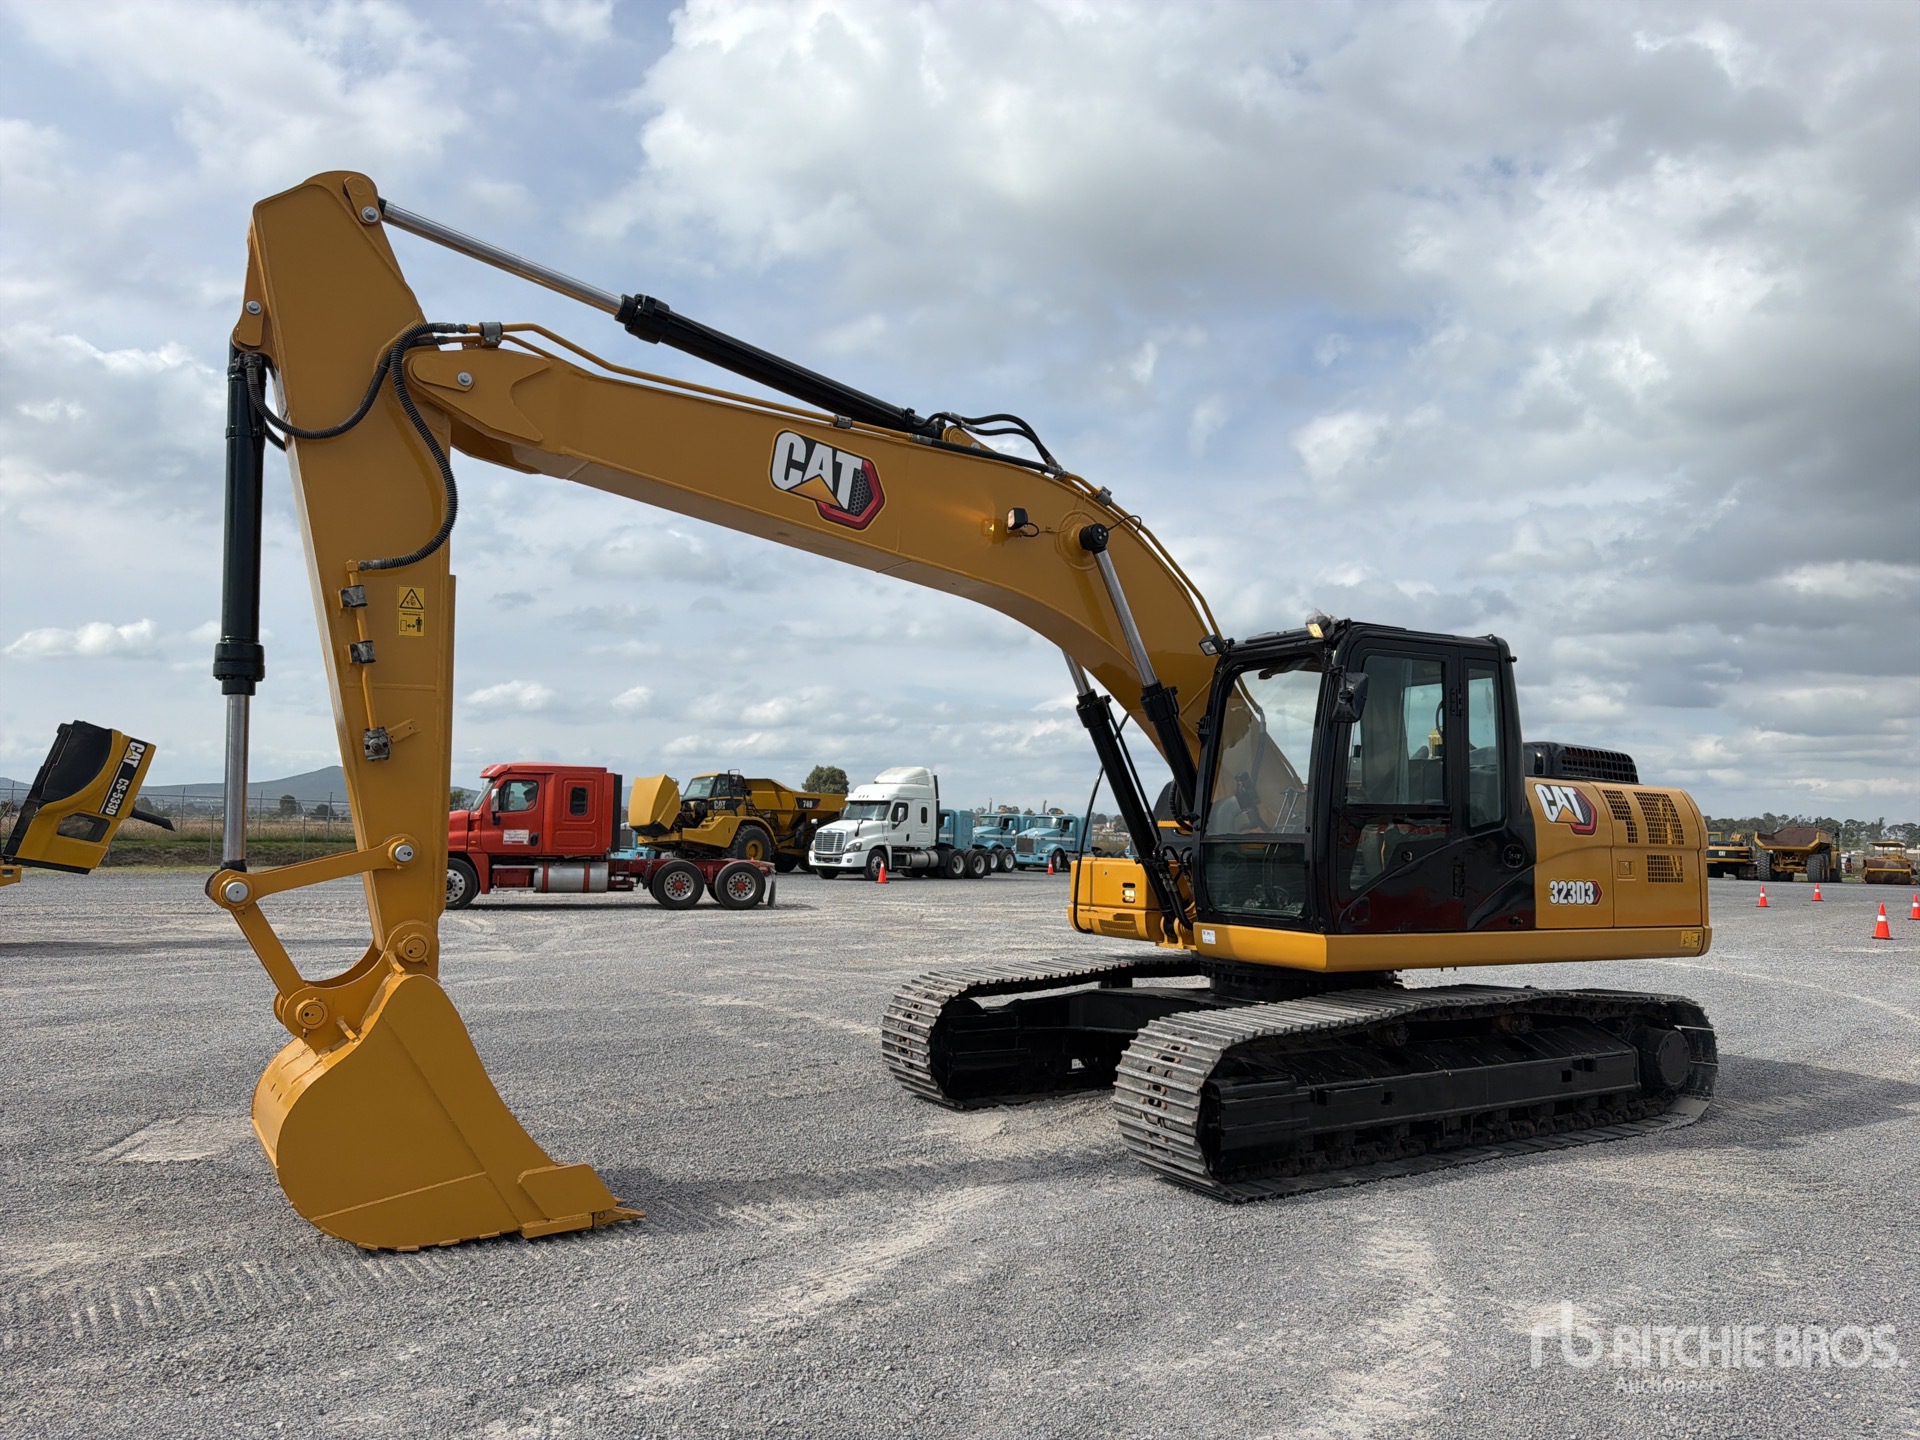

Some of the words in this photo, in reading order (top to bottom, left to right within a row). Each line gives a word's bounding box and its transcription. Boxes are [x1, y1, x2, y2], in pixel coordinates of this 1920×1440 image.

[772, 432, 863, 510] CAT
[122, 741, 145, 768] CAT
[105, 778, 129, 815] CS-533D
[713, 800, 726, 810] CAT
[1534, 784, 1585, 823] CAT
[1549, 880, 1595, 905] 323D3
